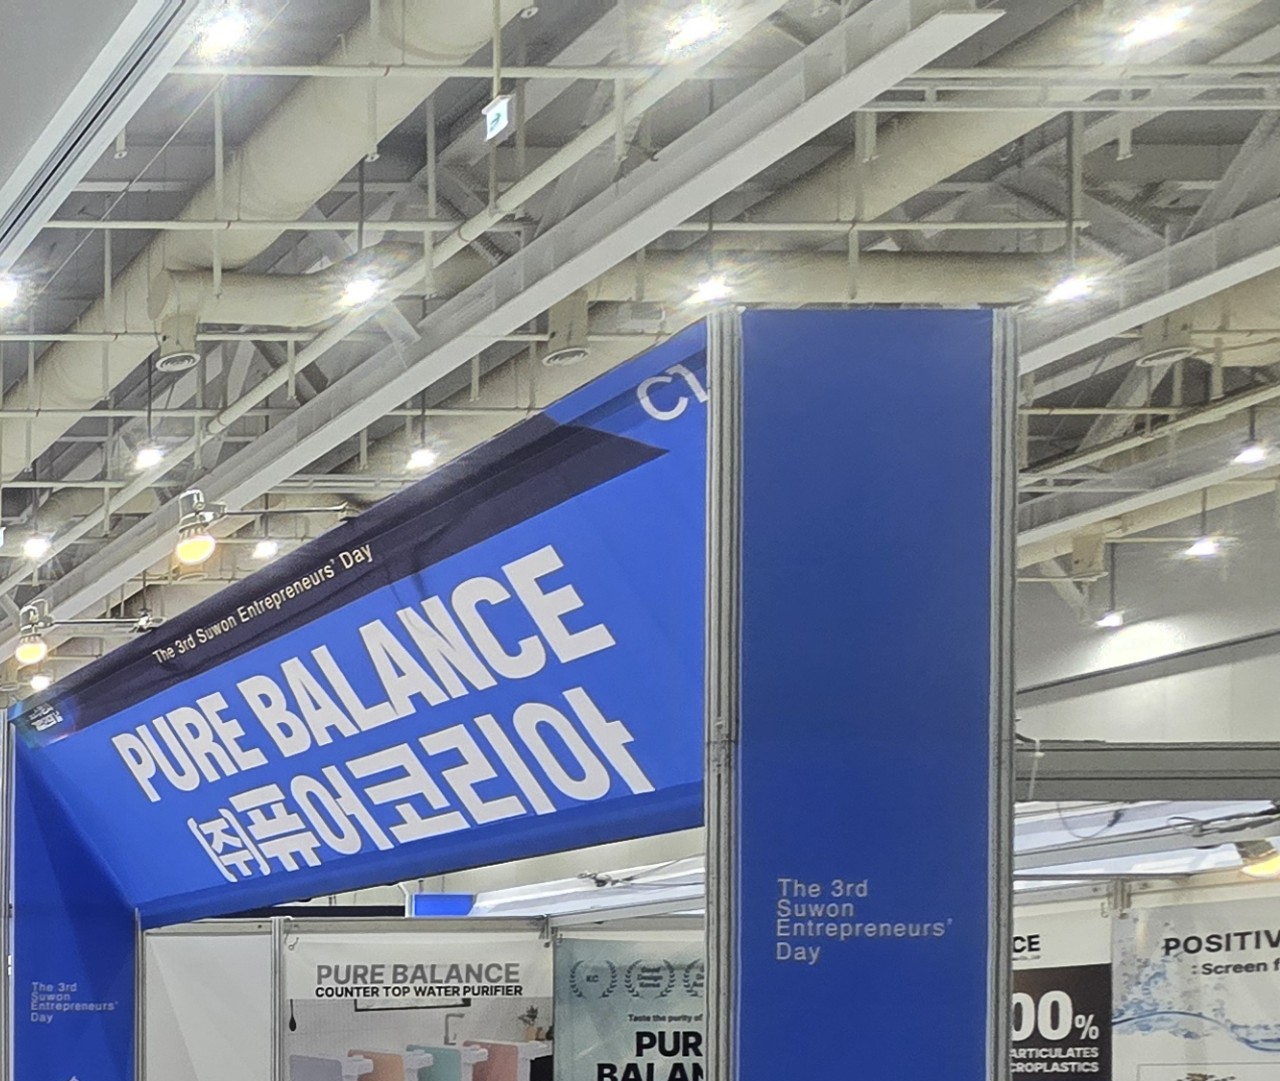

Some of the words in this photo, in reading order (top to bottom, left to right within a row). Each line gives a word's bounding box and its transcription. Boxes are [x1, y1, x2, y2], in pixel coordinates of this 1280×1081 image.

[152, 644, 176, 664] The
[175, 635, 196, 654] 3rd
[196, 614, 237, 644] Suwon
[339, 543, 374, 571] Day
[111, 691, 267, 803] PURE
[236, 545, 617, 760] BALANCE
[777, 877, 821, 898] The
[831, 878, 868, 898] 3rd
[777, 899, 855, 918] Suwon
[776, 942, 821, 966] Day
[317, 964, 385, 985] PURE
[392, 963, 520, 985] BALANCE
[1201, 962, 1268, 976] Screen
[637, 974, 663, 983] Design
[31, 982, 54, 993] The
[58, 982, 78, 993] 3rd
[315, 986, 380, 998] COUNTER
[383, 986, 410, 998] TOP
[413, 985, 460, 997] WATER
[463, 985, 523, 997] PURIFIER
[31, 992, 71, 1001] Suwon
[31, 1013, 53, 1023] Day
[628, 1014, 651, 1022] Taste
[653, 1014, 666, 1022] the
[668, 1014, 692, 1024] purity
